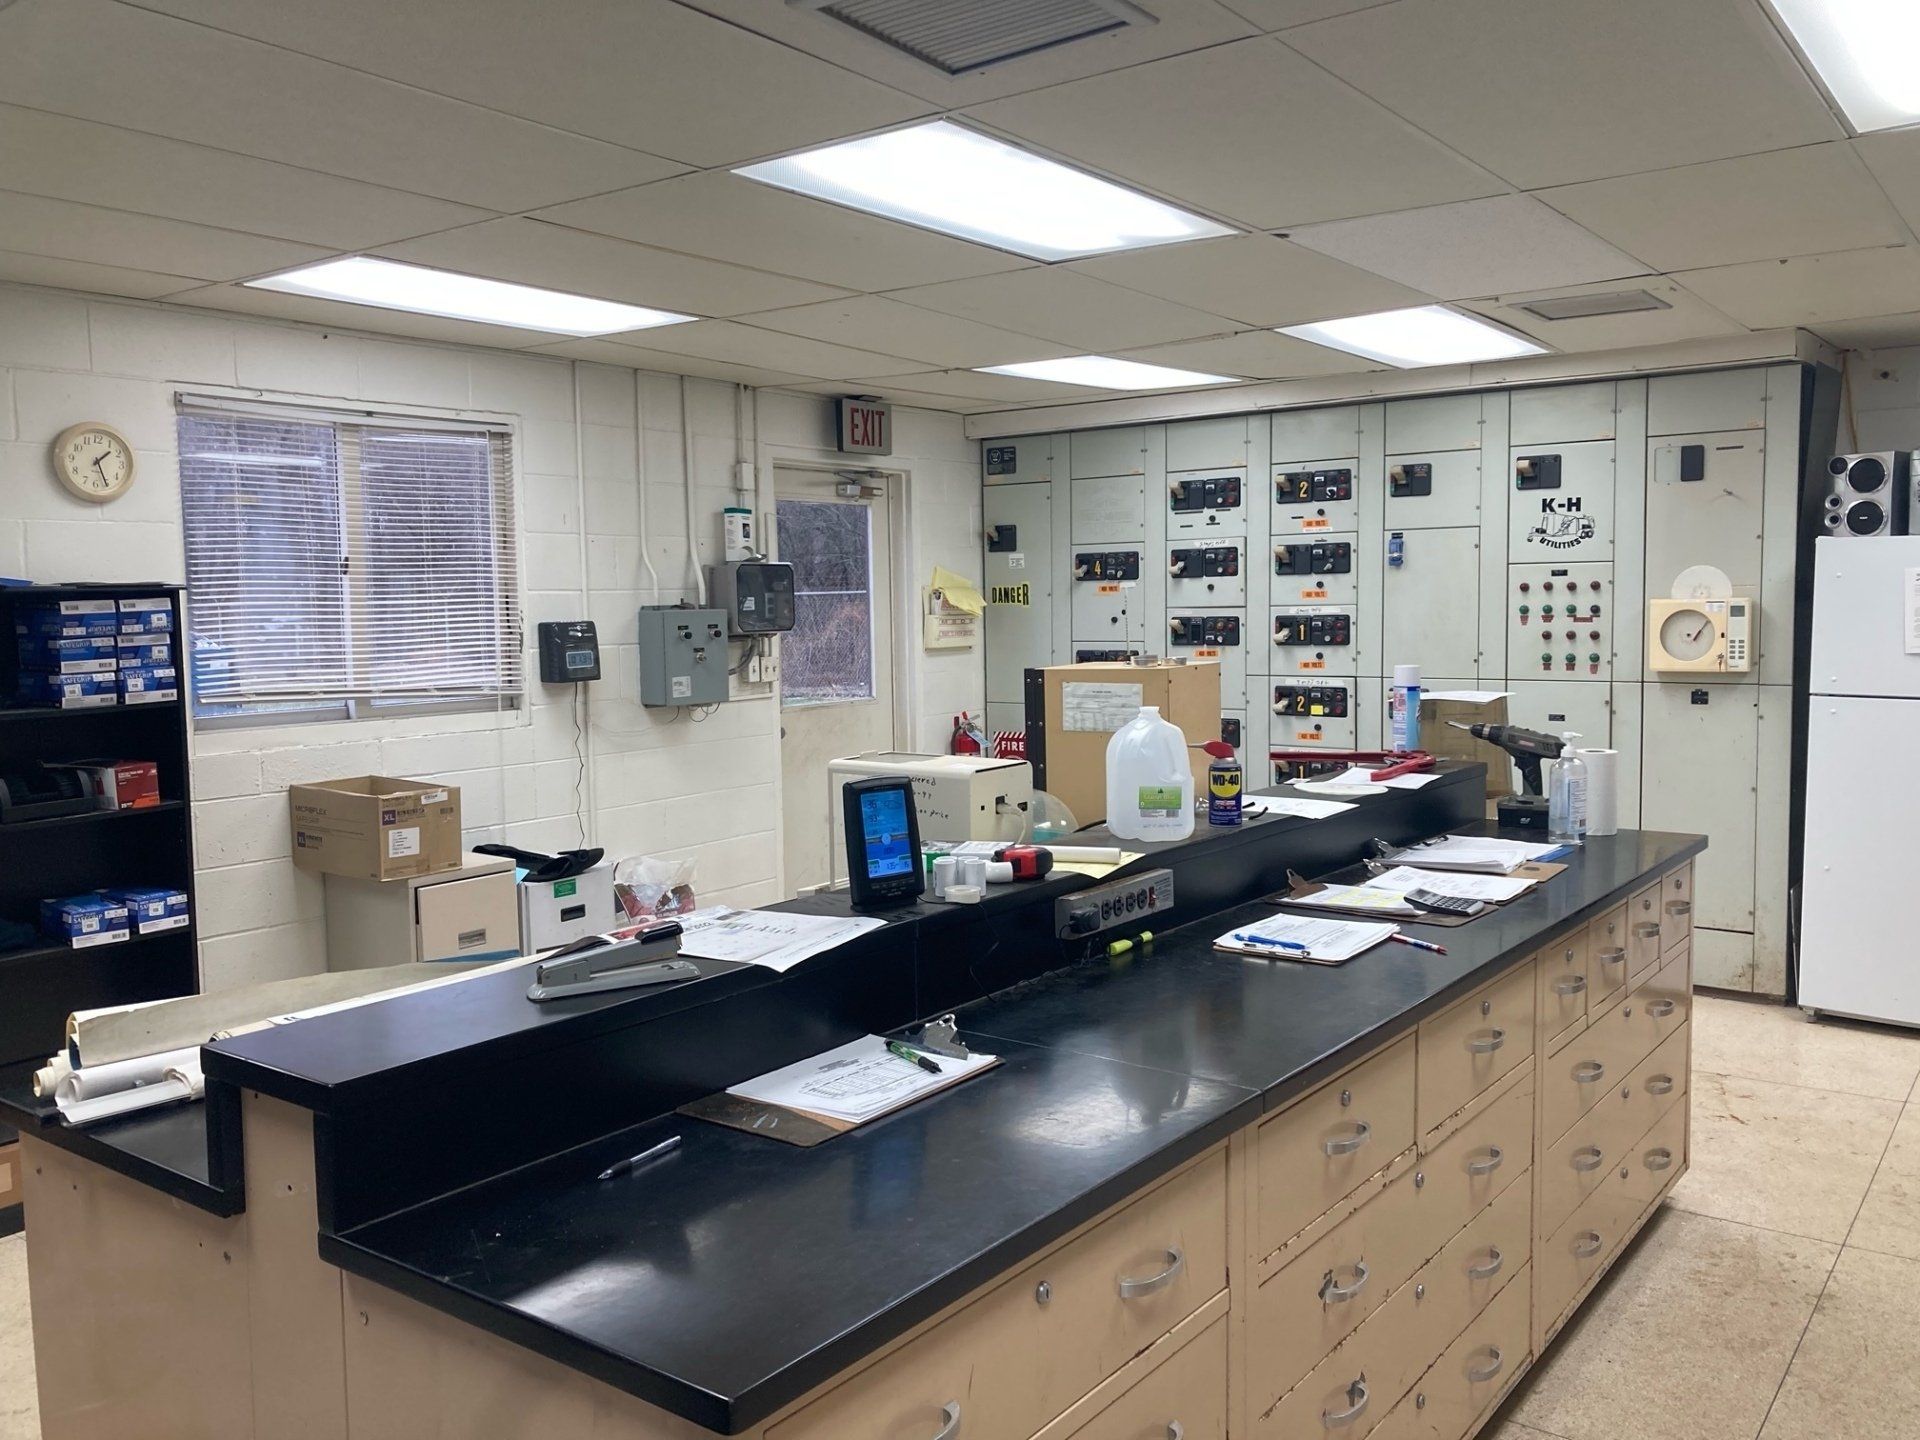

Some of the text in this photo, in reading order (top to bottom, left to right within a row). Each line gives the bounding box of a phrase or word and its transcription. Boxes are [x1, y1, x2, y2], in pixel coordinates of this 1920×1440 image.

[850, 407, 885, 448] EXIT
[83, 436, 91, 445] 11
[93, 434, 103, 444] 12
[74, 443, 83, 452] 10
[68, 454, 75, 462] 9
[115, 449, 121, 458] 2
[72, 466, 78, 475] 8
[118, 461, 125, 470] 3
[92, 480, 99, 488] 6
[1299, 481, 1309, 498] 2
[1541, 497, 1582, 514] K-H
[1539, 537, 1582, 549] UTILITIES
[1094, 560, 1102, 575] 4
[991, 584, 1029, 605] DANGER
[1299, 624, 1305, 641] 1
[1296, 695, 1306, 712] 2
[1001, 741, 1025, 752] FIRE
[1211, 774, 1240, 787] WD-40
[383, 813, 396, 822] XL
